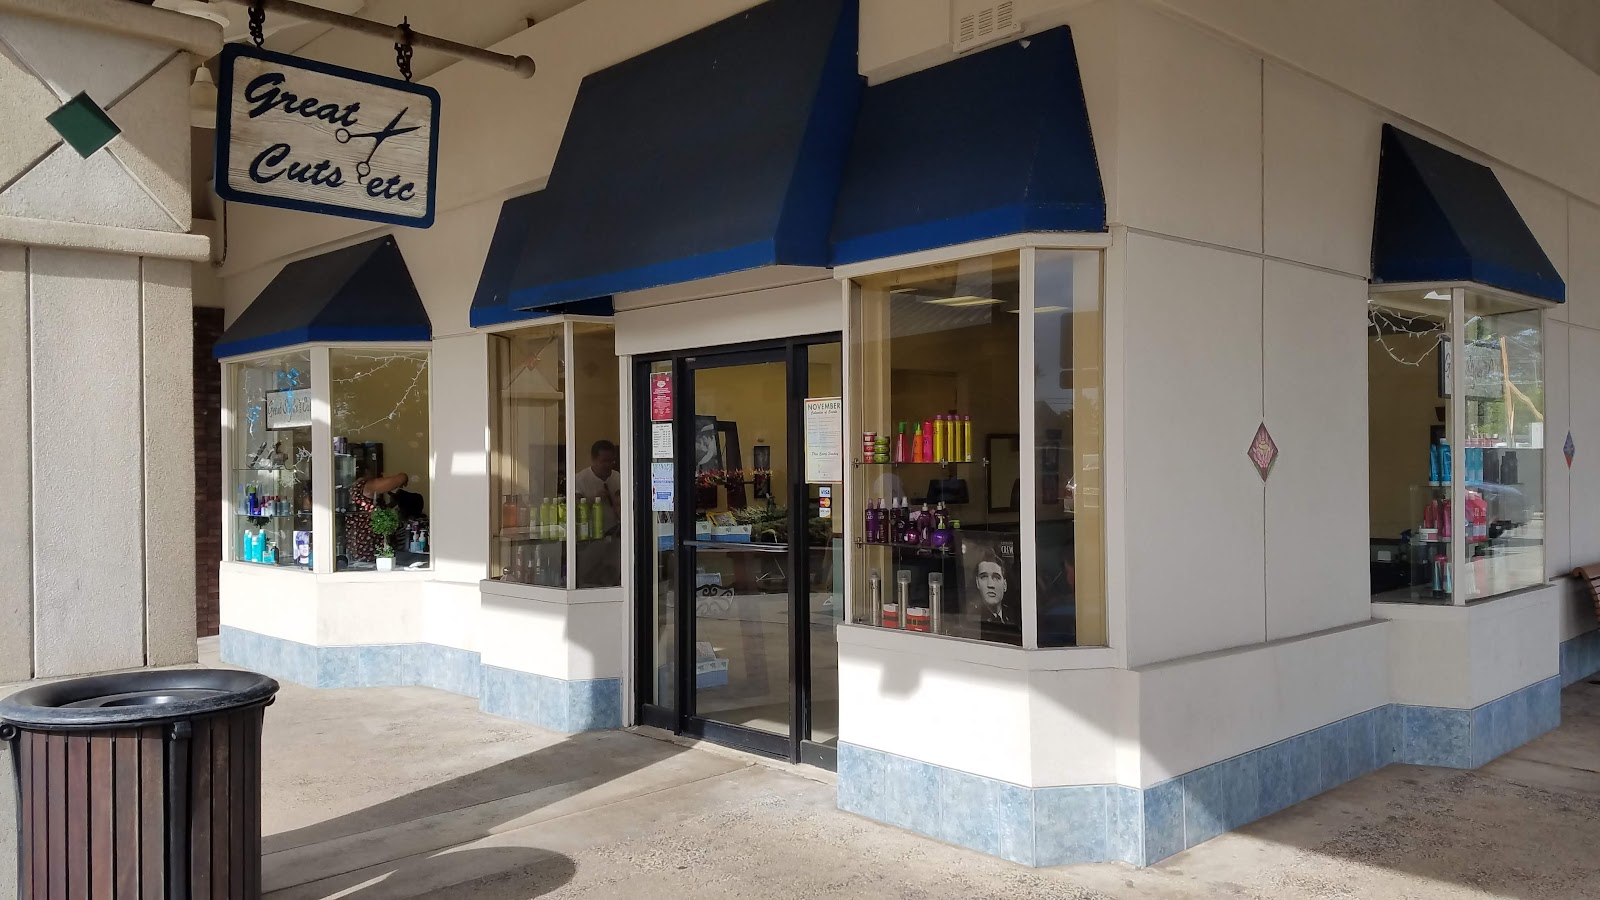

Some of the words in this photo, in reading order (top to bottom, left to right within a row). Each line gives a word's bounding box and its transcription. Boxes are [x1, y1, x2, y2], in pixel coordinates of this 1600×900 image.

[244, 72, 361, 127] Great
[249, 143, 346, 188] Cuts
[366, 174, 416, 202] etc
[808, 403, 841, 411] NOVEMBER
